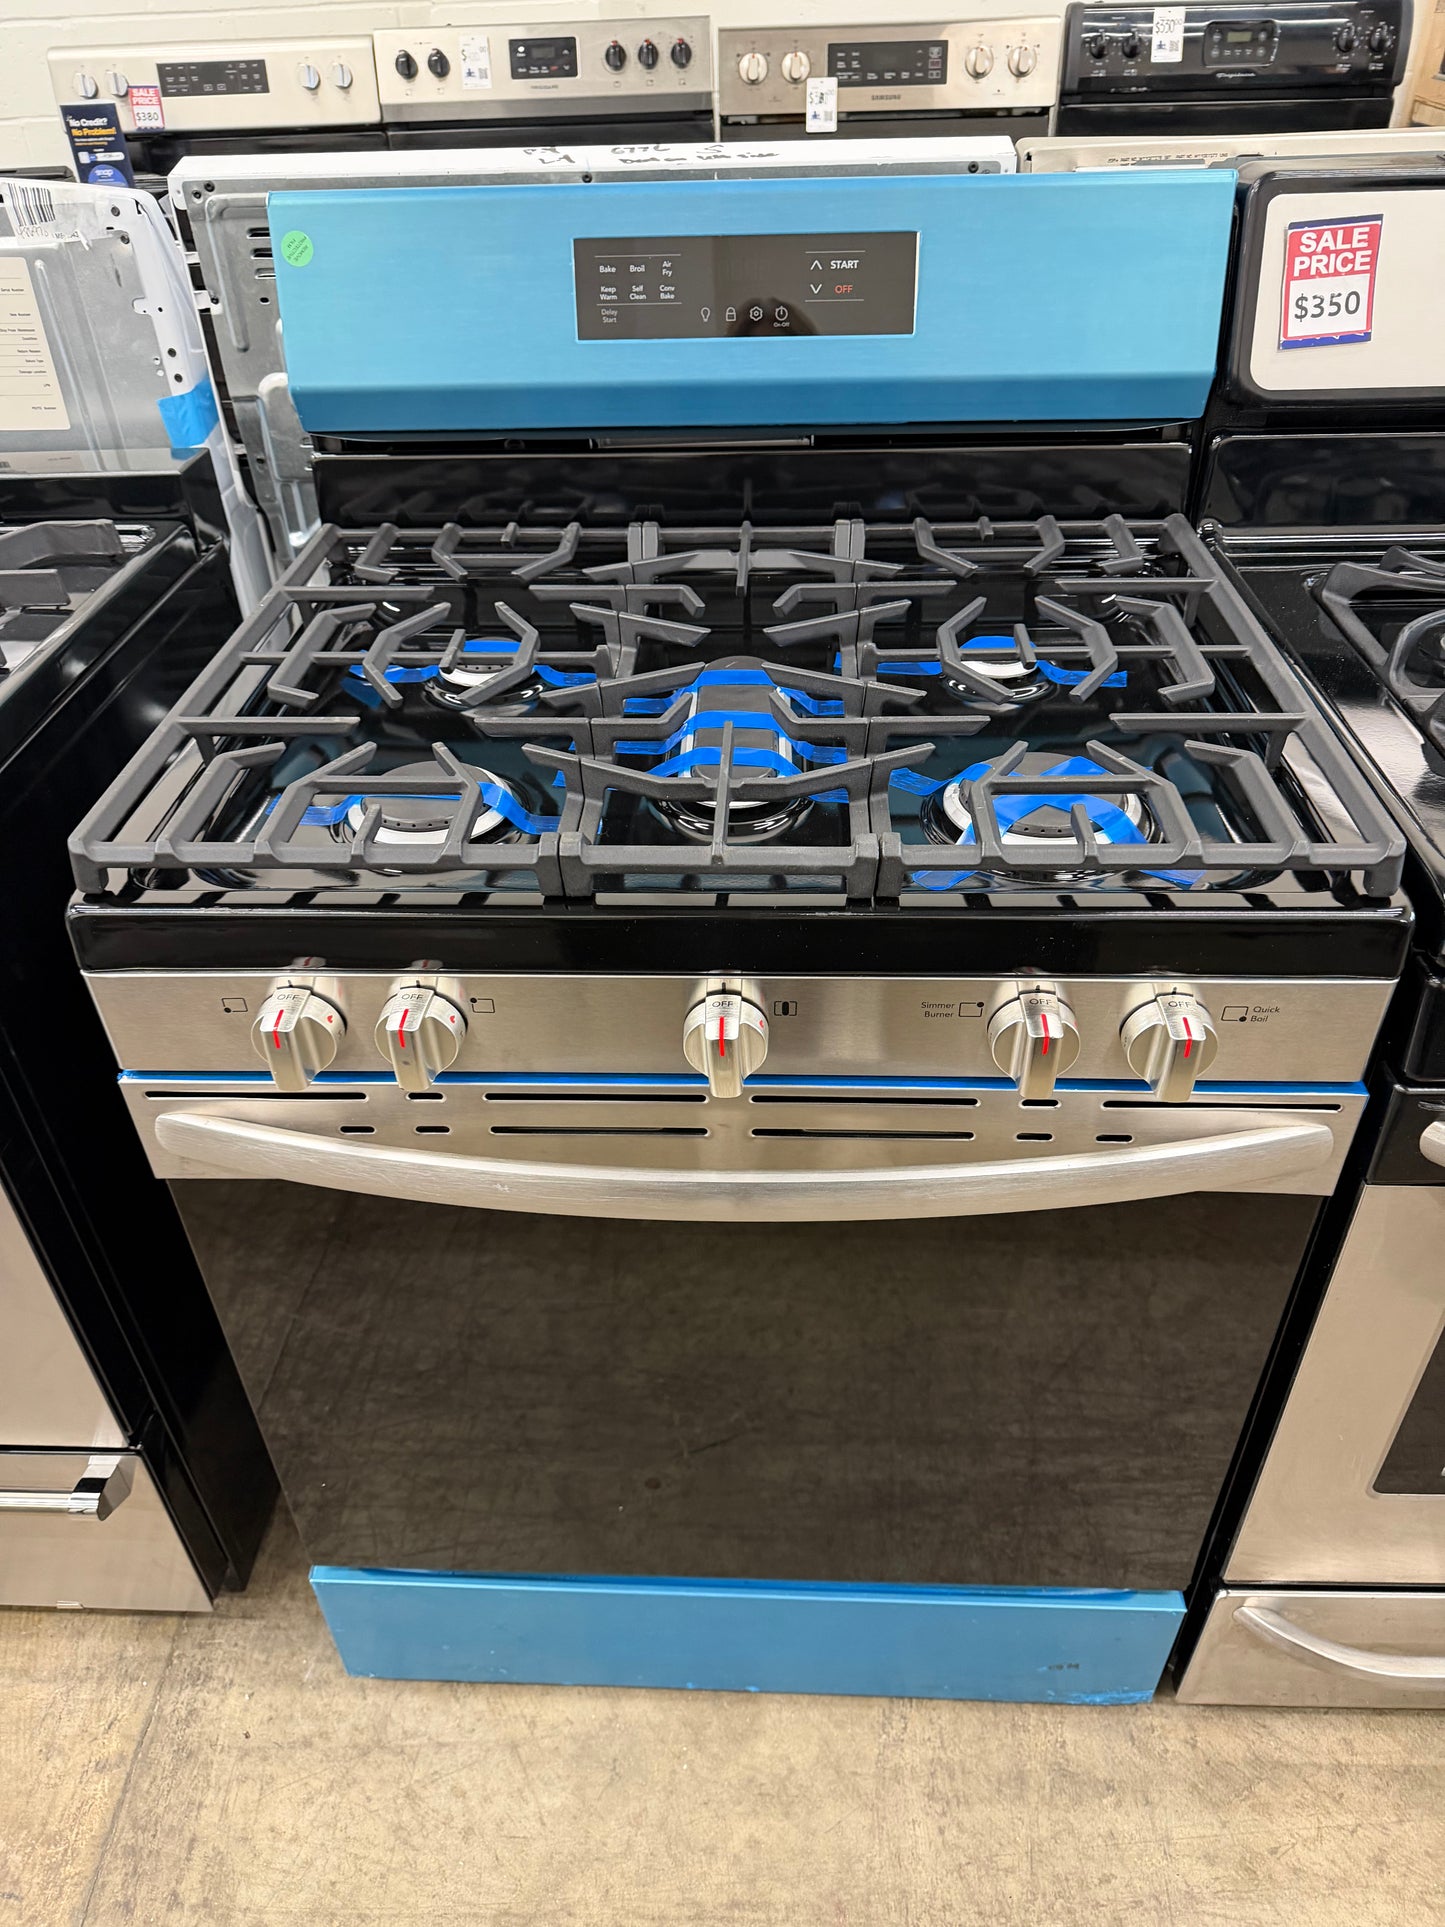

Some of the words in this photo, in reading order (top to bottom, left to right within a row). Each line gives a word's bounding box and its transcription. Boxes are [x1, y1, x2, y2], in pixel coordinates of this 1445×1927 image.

[133, 88, 156, 96] SALE
[132, 97, 160, 105] PRICE
[1300, 227, 1371, 253] SALE
[662, 260, 672, 268] Air
[830, 260, 859, 270] START
[1293, 250, 1373, 277] PRICE
[599, 265, 616, 273] Bake
[629, 264, 645, 273] Broil
[662, 268, 673, 277] Fry
[600, 286, 617, 294] Keep
[659, 284, 675, 292] Conv
[834, 285, 854, 294] OFF
[1294, 290, 1361, 322] $350
[601, 308, 618, 317] Delay
[921, 1001, 955, 1009] Simmer
[924, 1010, 954, 1018] Burner
